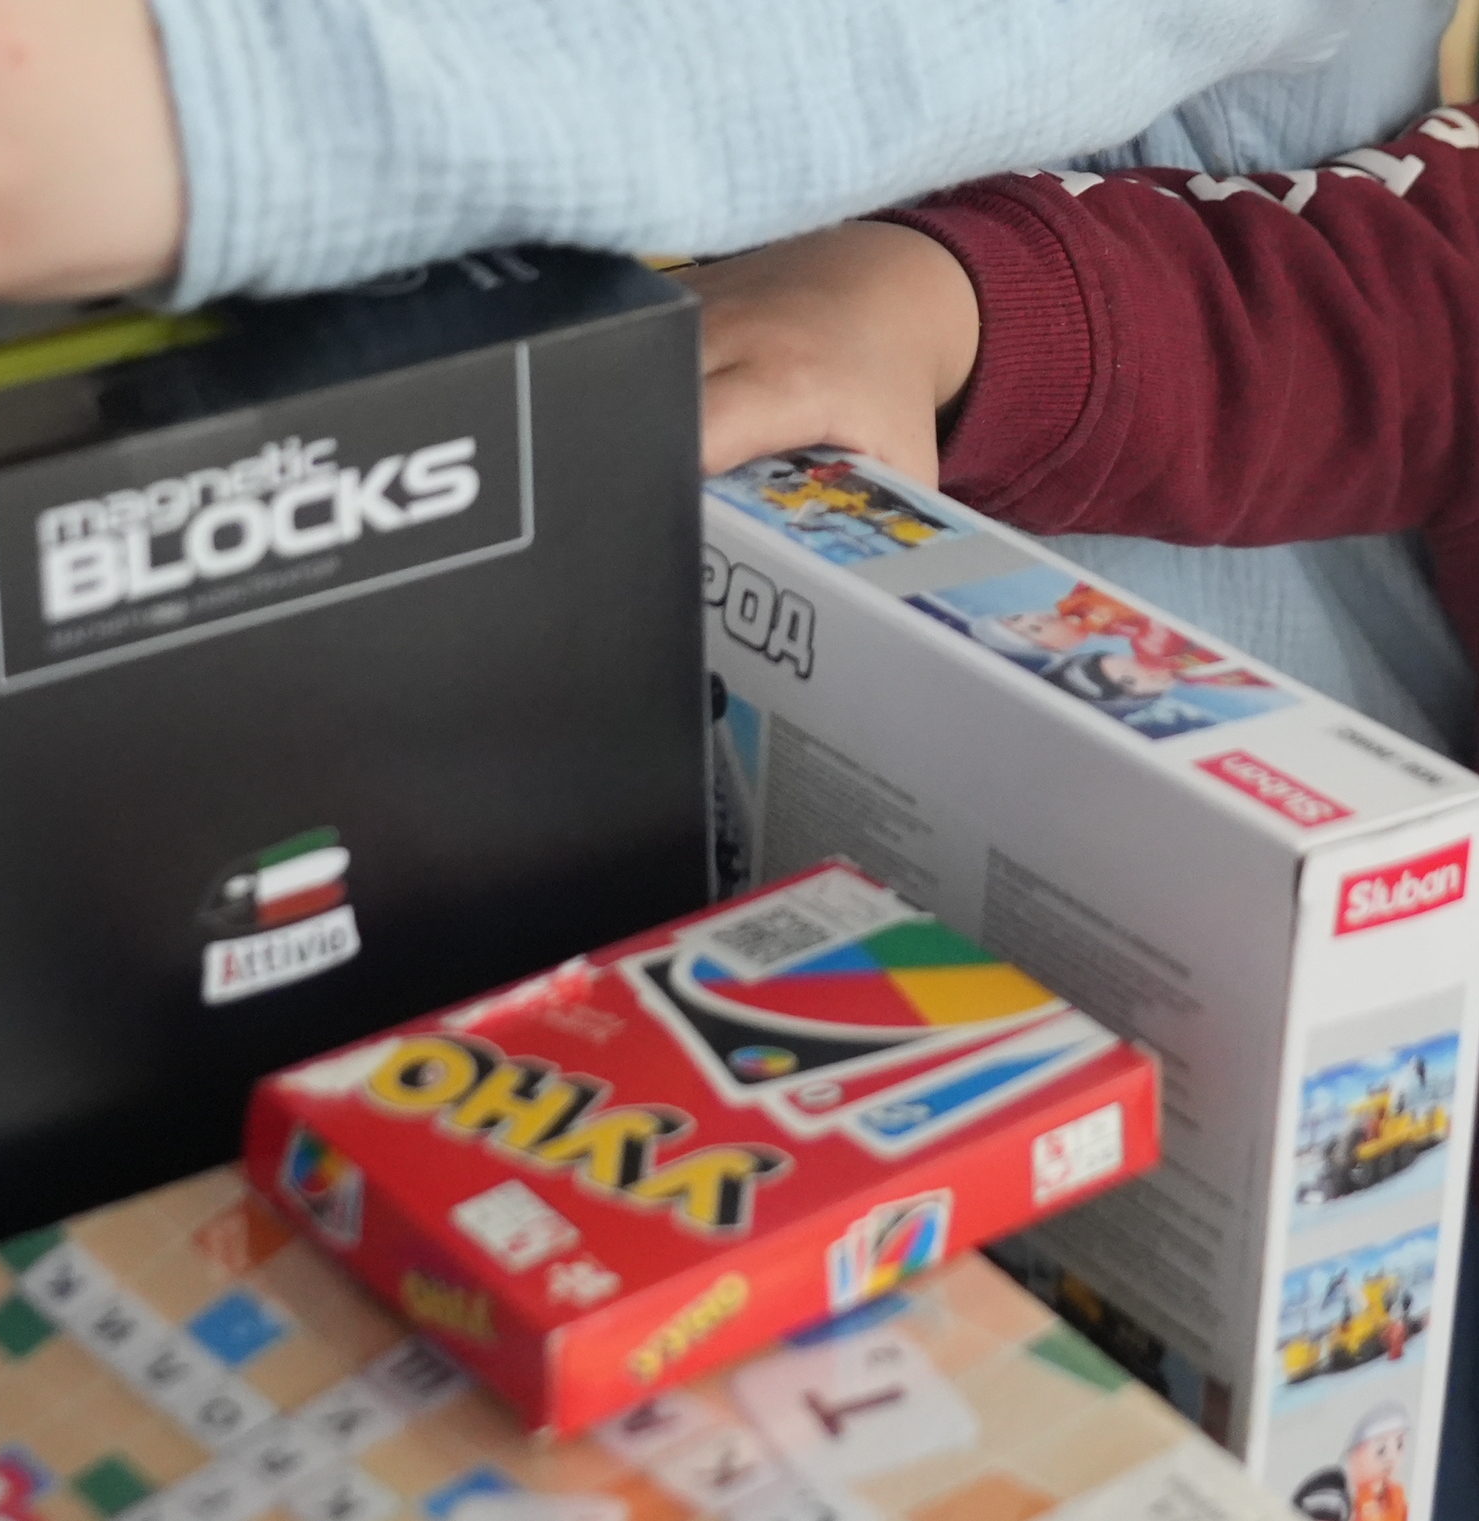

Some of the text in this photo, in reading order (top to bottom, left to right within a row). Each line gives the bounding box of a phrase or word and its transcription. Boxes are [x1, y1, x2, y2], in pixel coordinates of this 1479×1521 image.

[36, 437, 338, 546] magnetic
[42, 437, 482, 624] BLOCKS
[1345, 859, 1464, 928] Sluban
[218, 923, 348, 989] Attivio
